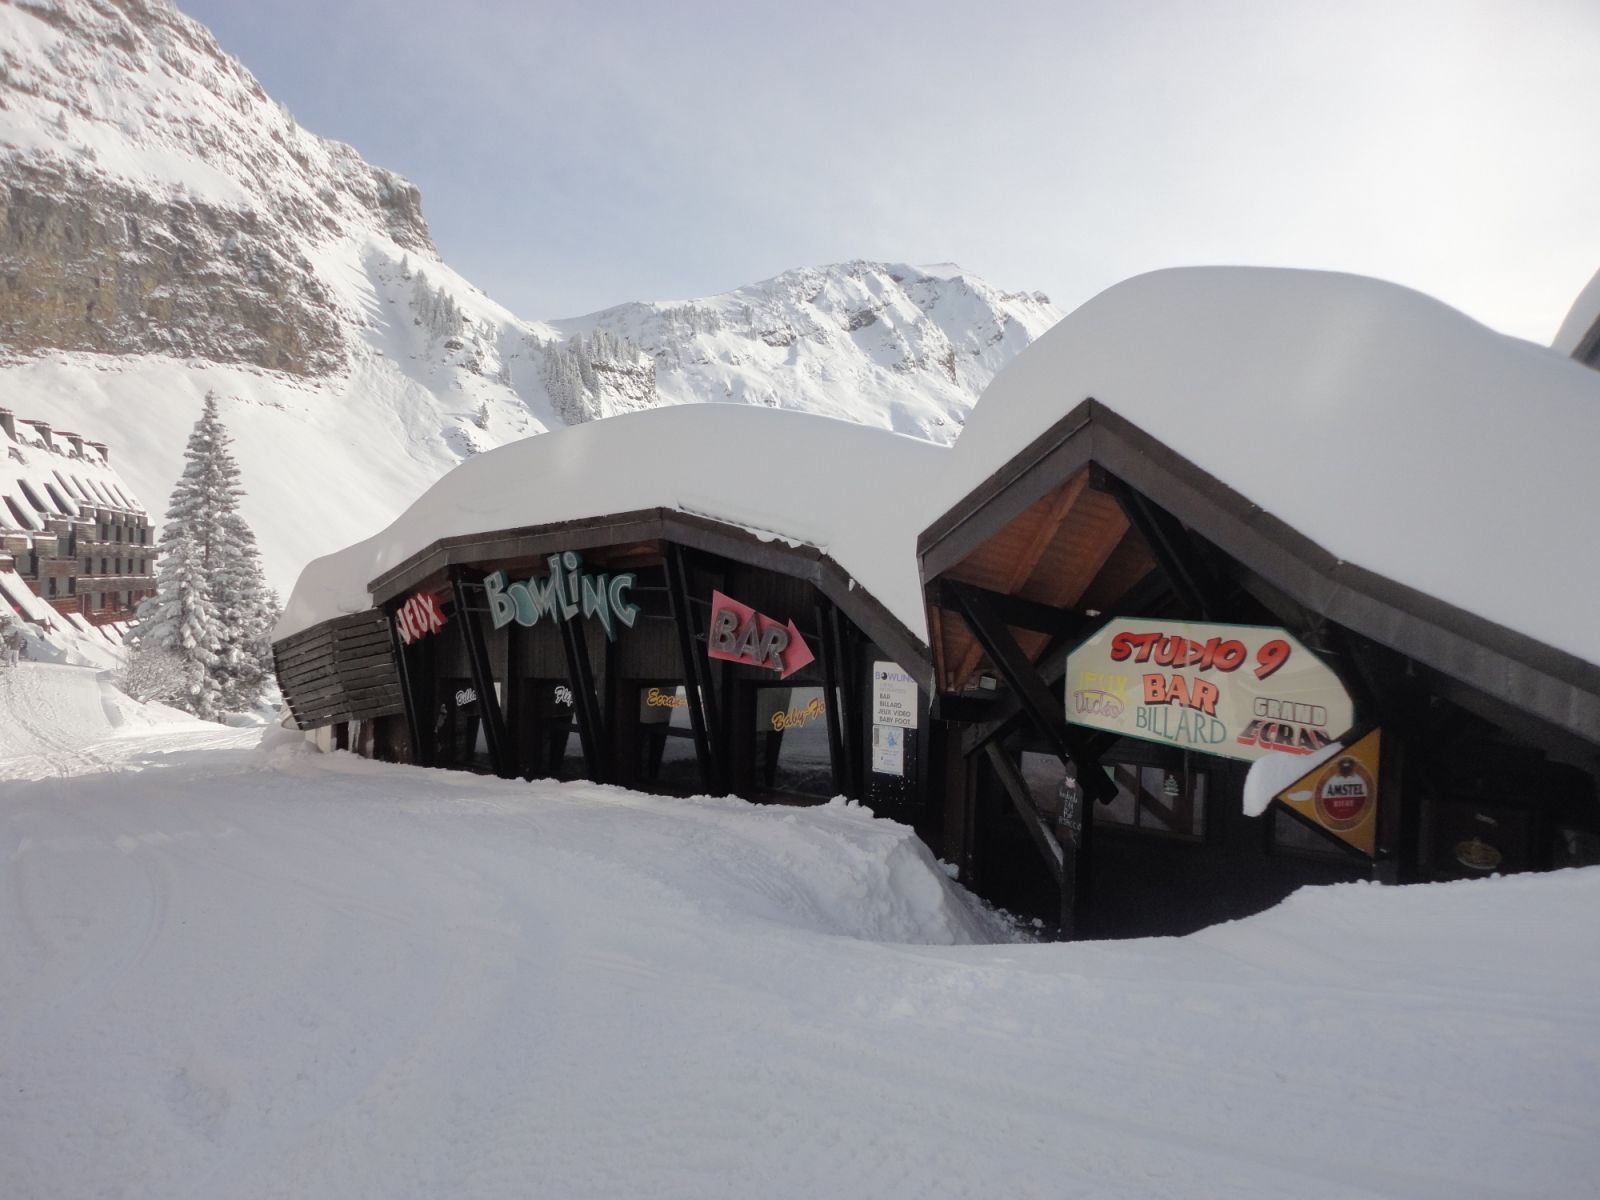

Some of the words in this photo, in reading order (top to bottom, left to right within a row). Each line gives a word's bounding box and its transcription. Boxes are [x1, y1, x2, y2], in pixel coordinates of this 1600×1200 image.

[397, 592, 448, 645] JEUX
[708, 608, 790, 672] BAR
[1110, 631, 1247, 673] STUDIO
[1253, 639, 1291, 681] 9
[771, 696, 826, 732] Baby-Fo
[1142, 673, 1220, 718] BAR
[1253, 696, 1327, 727] GRAND
[1135, 706, 1227, 745] BILLARD
[1327, 783, 1365, 796] AMSTEL
